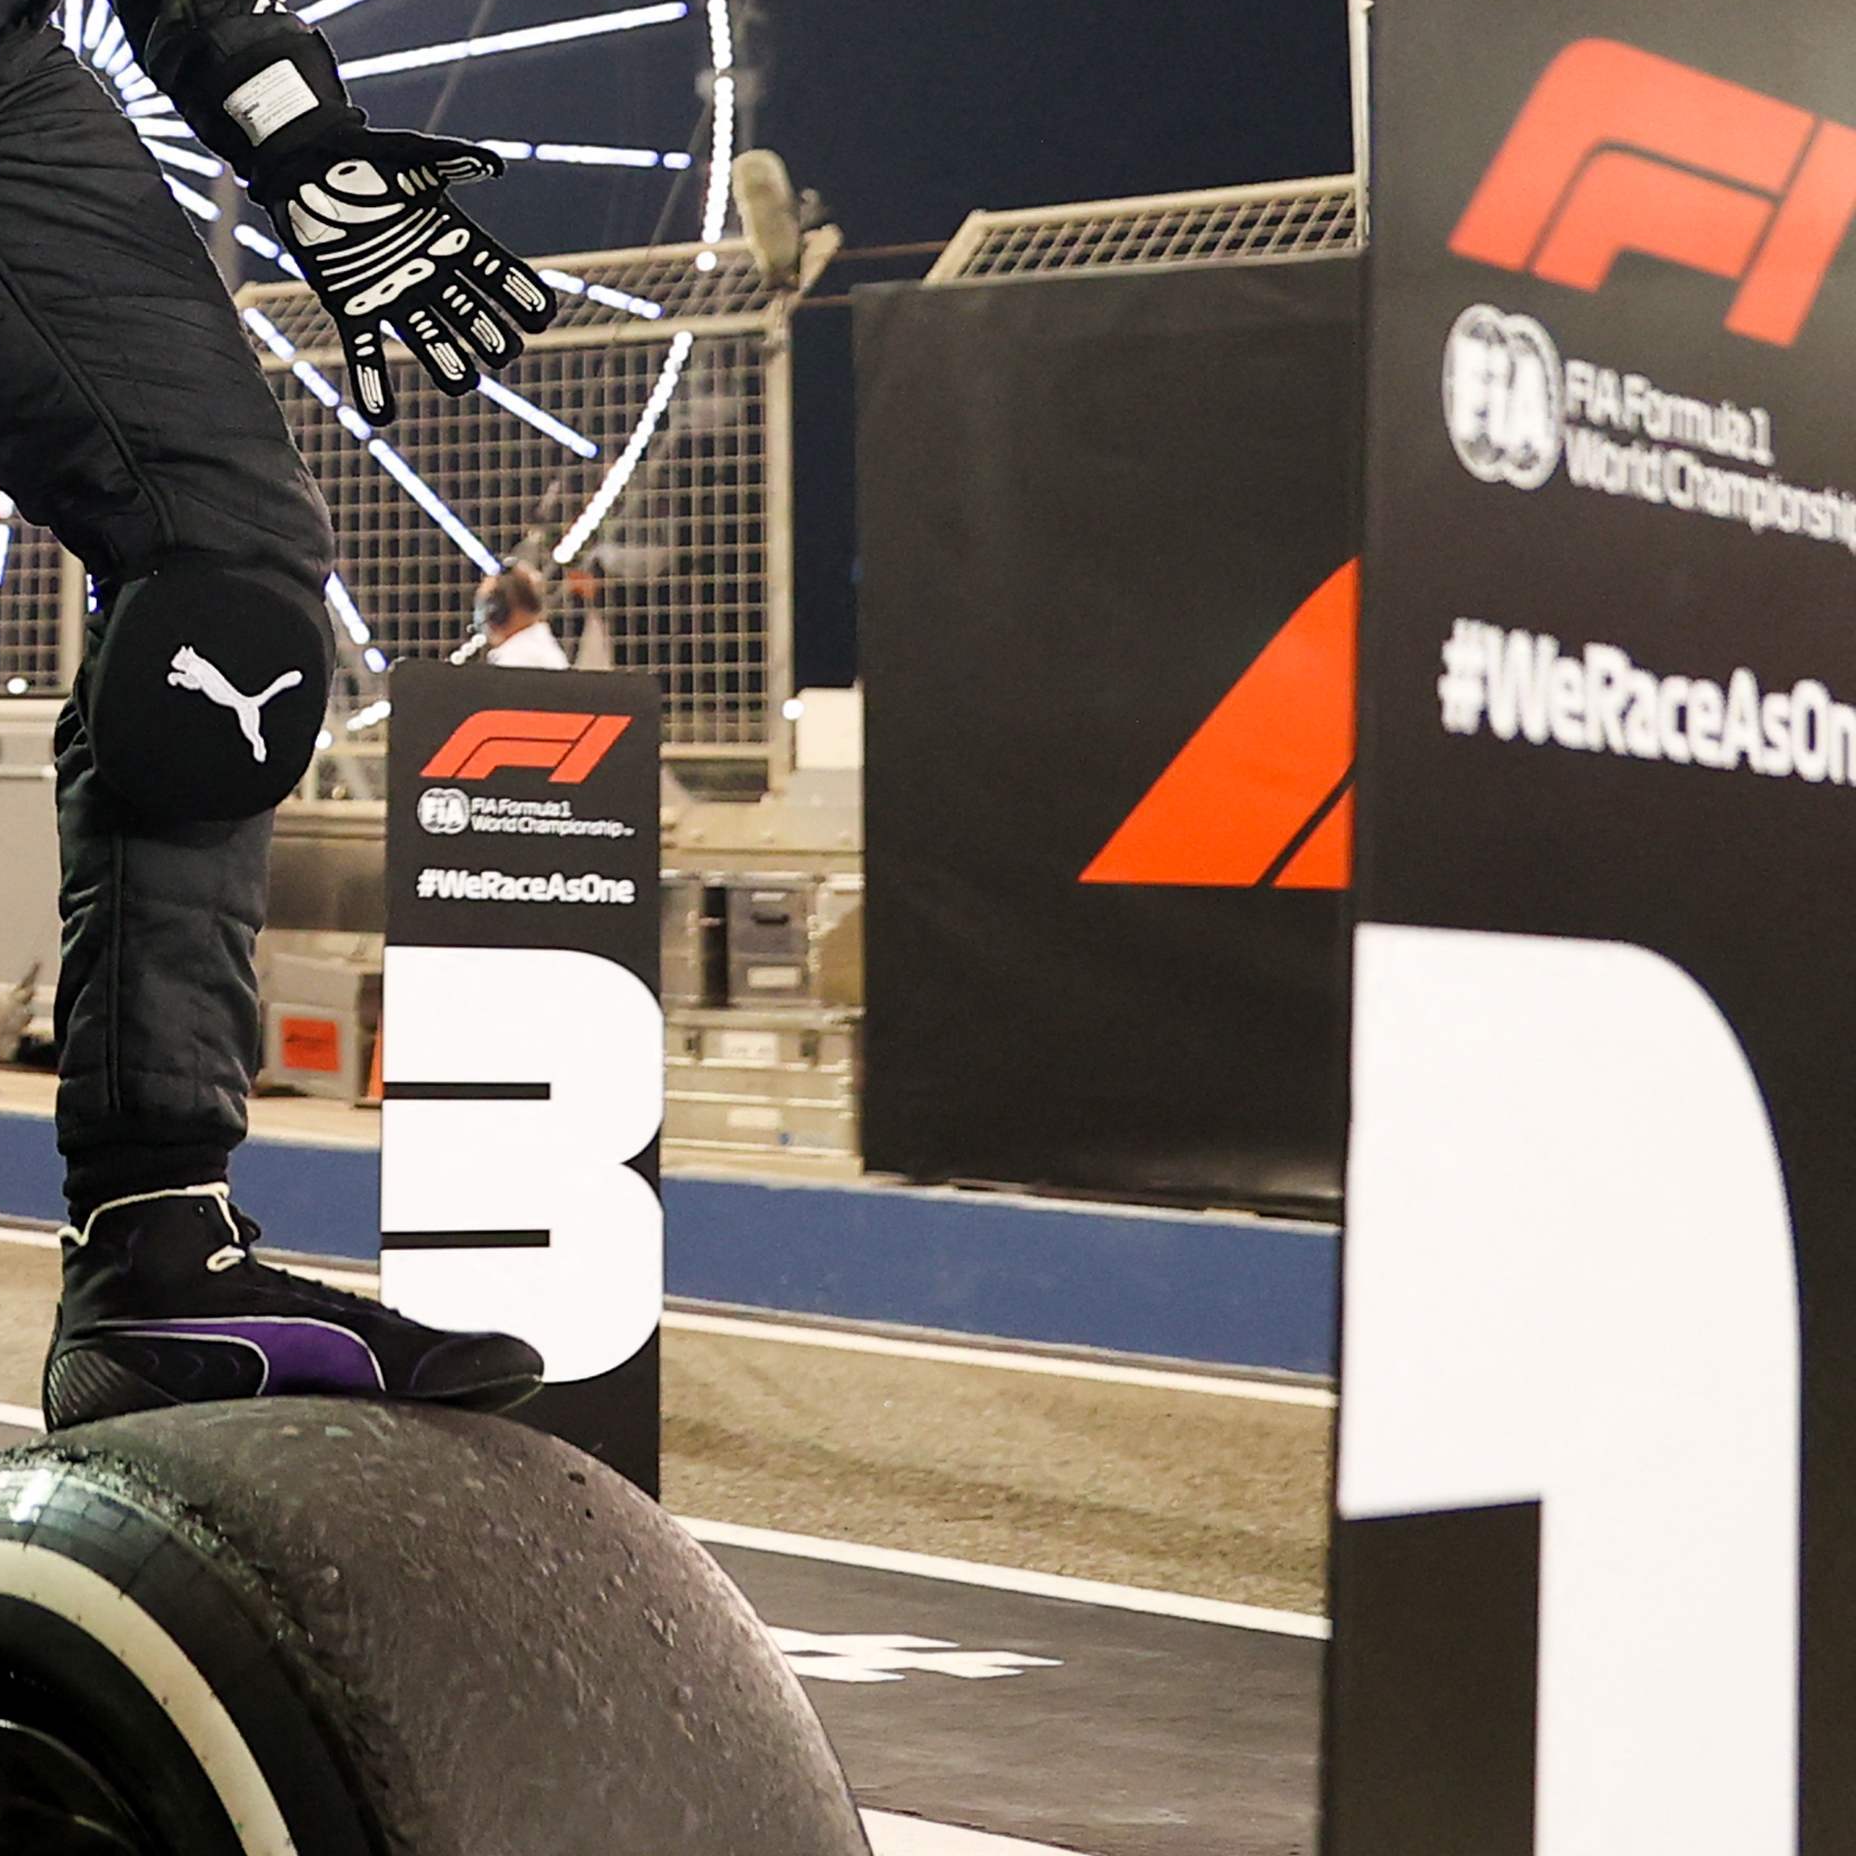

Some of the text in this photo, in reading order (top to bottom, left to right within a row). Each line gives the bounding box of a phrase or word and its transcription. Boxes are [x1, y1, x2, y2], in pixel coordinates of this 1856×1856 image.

[1565, 428, 1663, 504] World
[471, 797, 573, 818] FIA Formula 1
[471, 815, 624, 838] World Championship
[416, 868, 636, 904] #WeRaceAsOne
[380, 946, 665, 1384] 3
[1338, 921, 1804, 1856] 1
